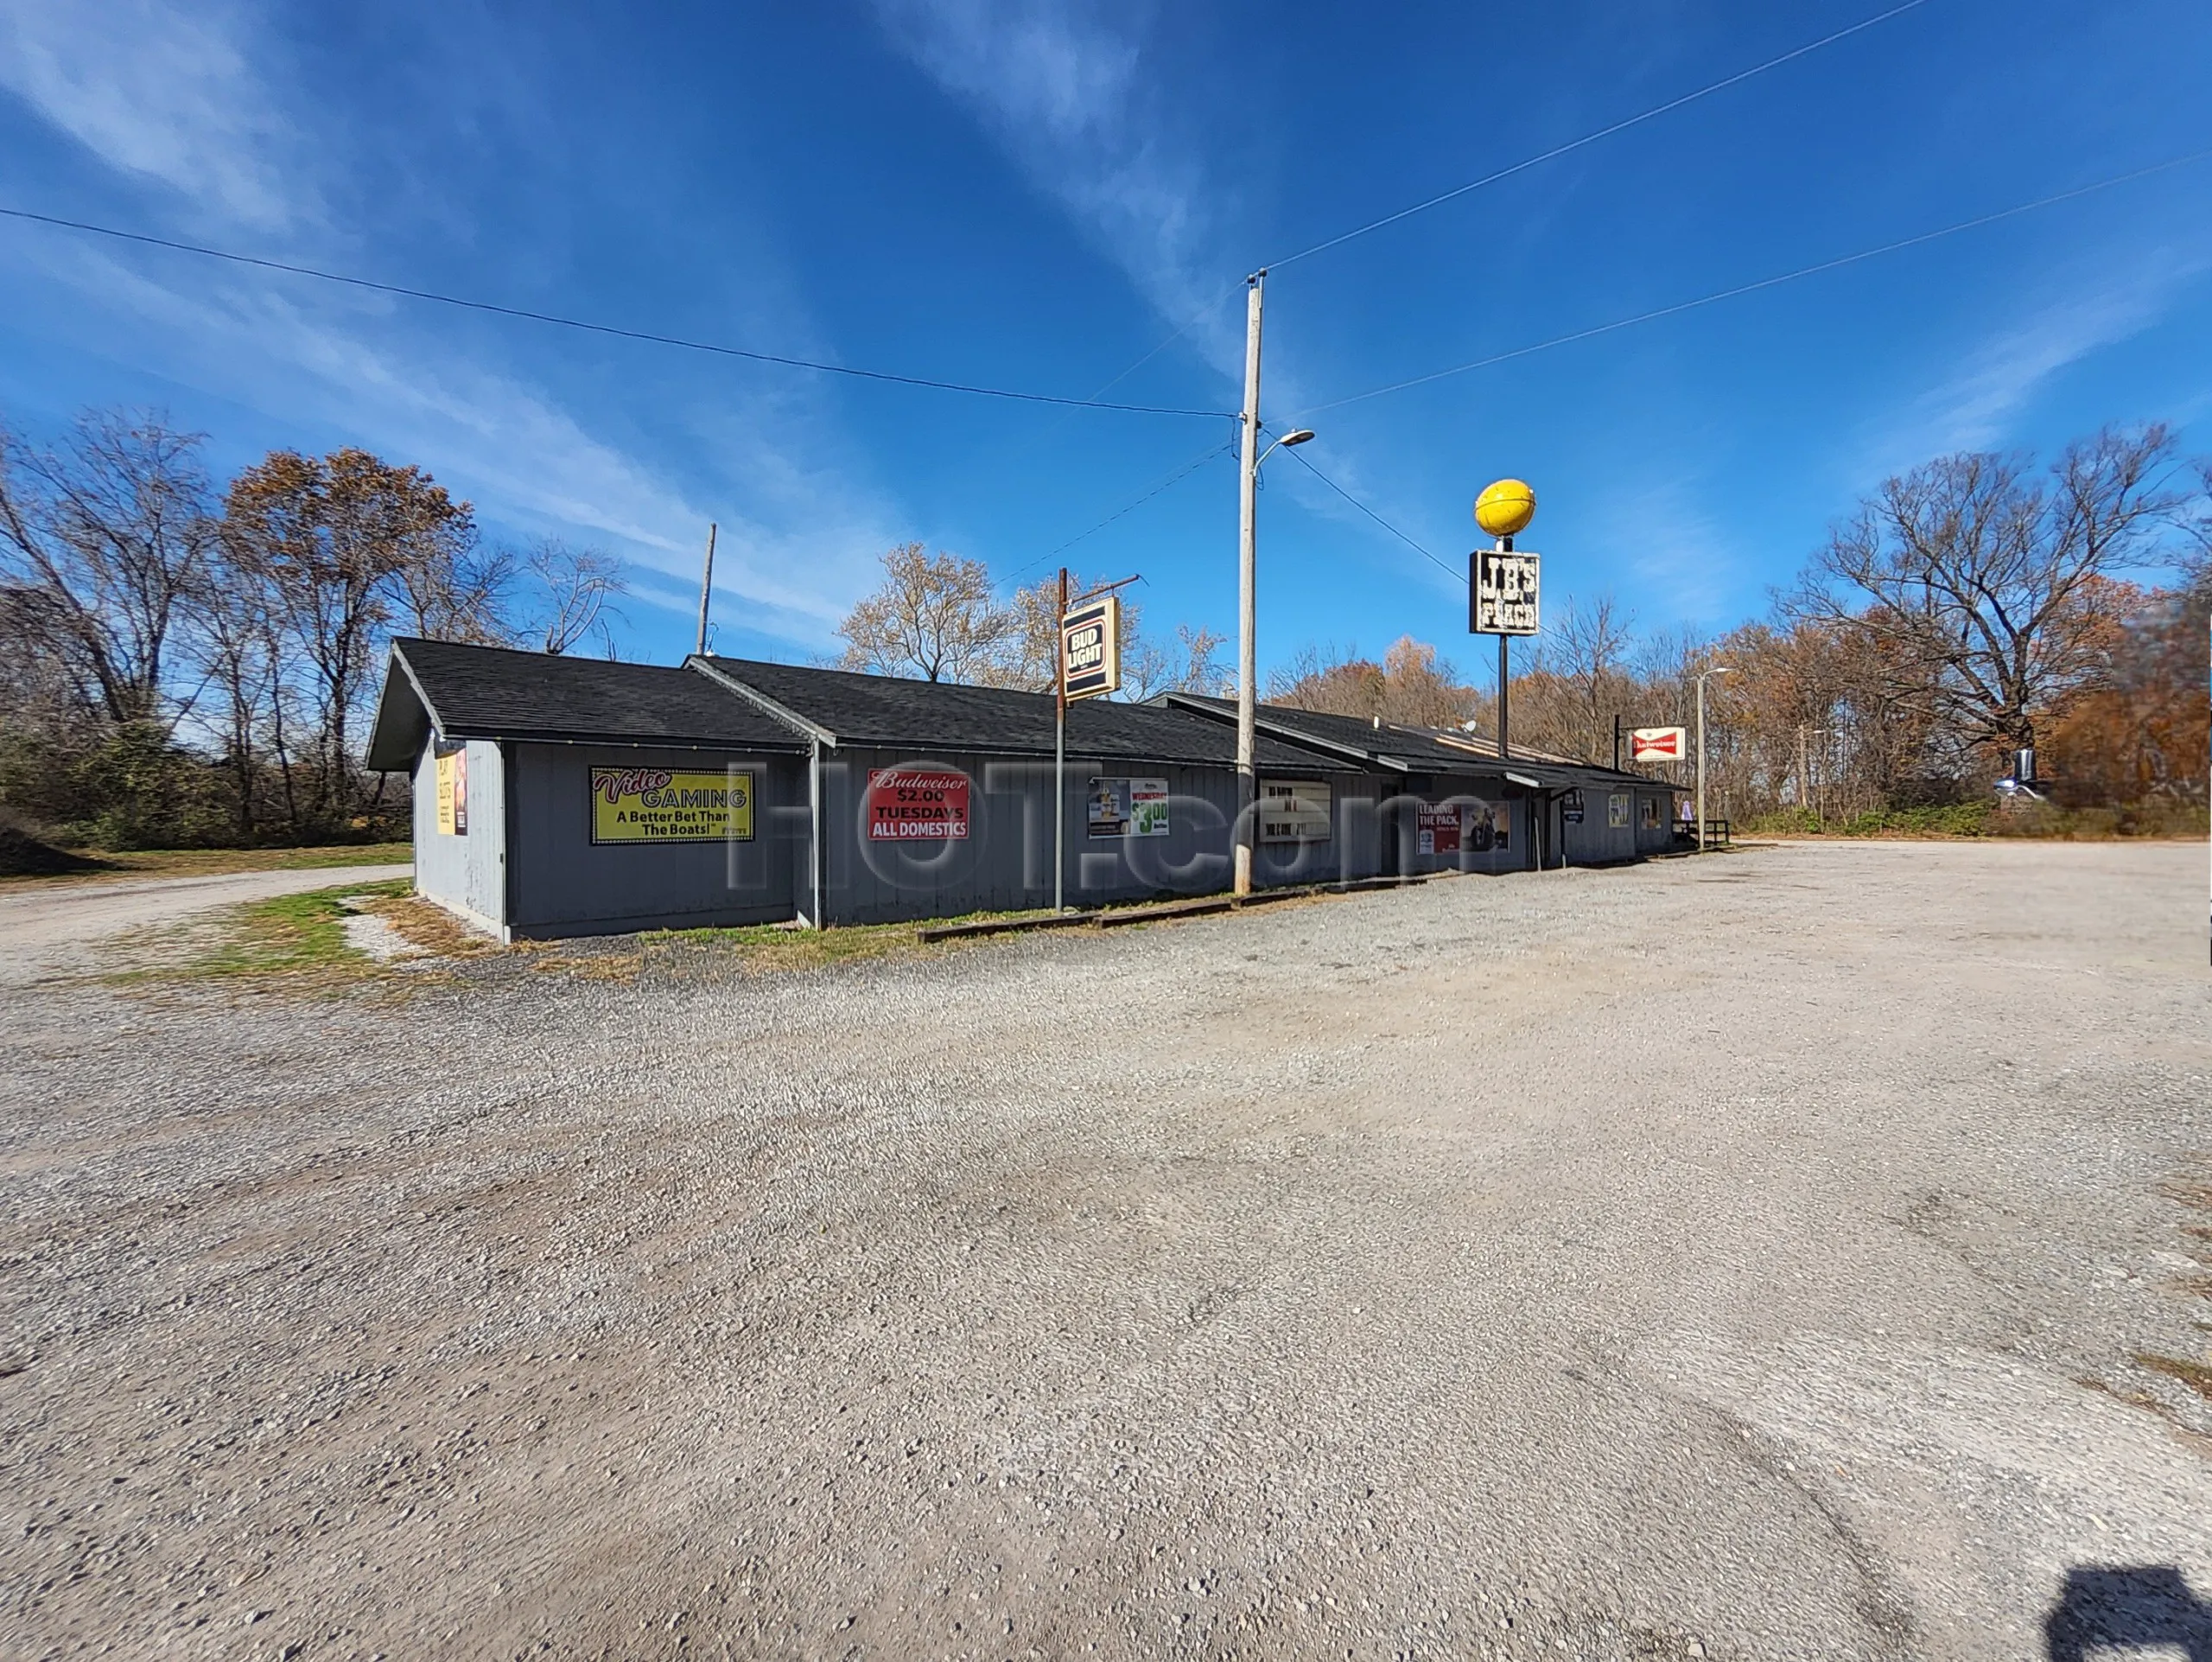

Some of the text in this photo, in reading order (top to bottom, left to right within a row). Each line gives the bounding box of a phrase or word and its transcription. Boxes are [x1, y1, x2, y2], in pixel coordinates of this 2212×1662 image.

[1071, 628, 1098, 651] BUD
[1068, 643, 1103, 669] LIGHT
[594, 769, 672, 804] Video
[871, 771, 967, 790] Budweiser
[641, 788, 747, 809] GAMING
[897, 790, 944, 803] $2.00
[875, 806, 964, 819] TUESDAYS
[1420, 804, 1453, 815] LEADING
[616, 811, 731, 824] A Better Bet Than
[1420, 815, 1435, 826] THE
[643, 824, 668, 836] The
[873, 822, 966, 837] ALL DOMESTICS
